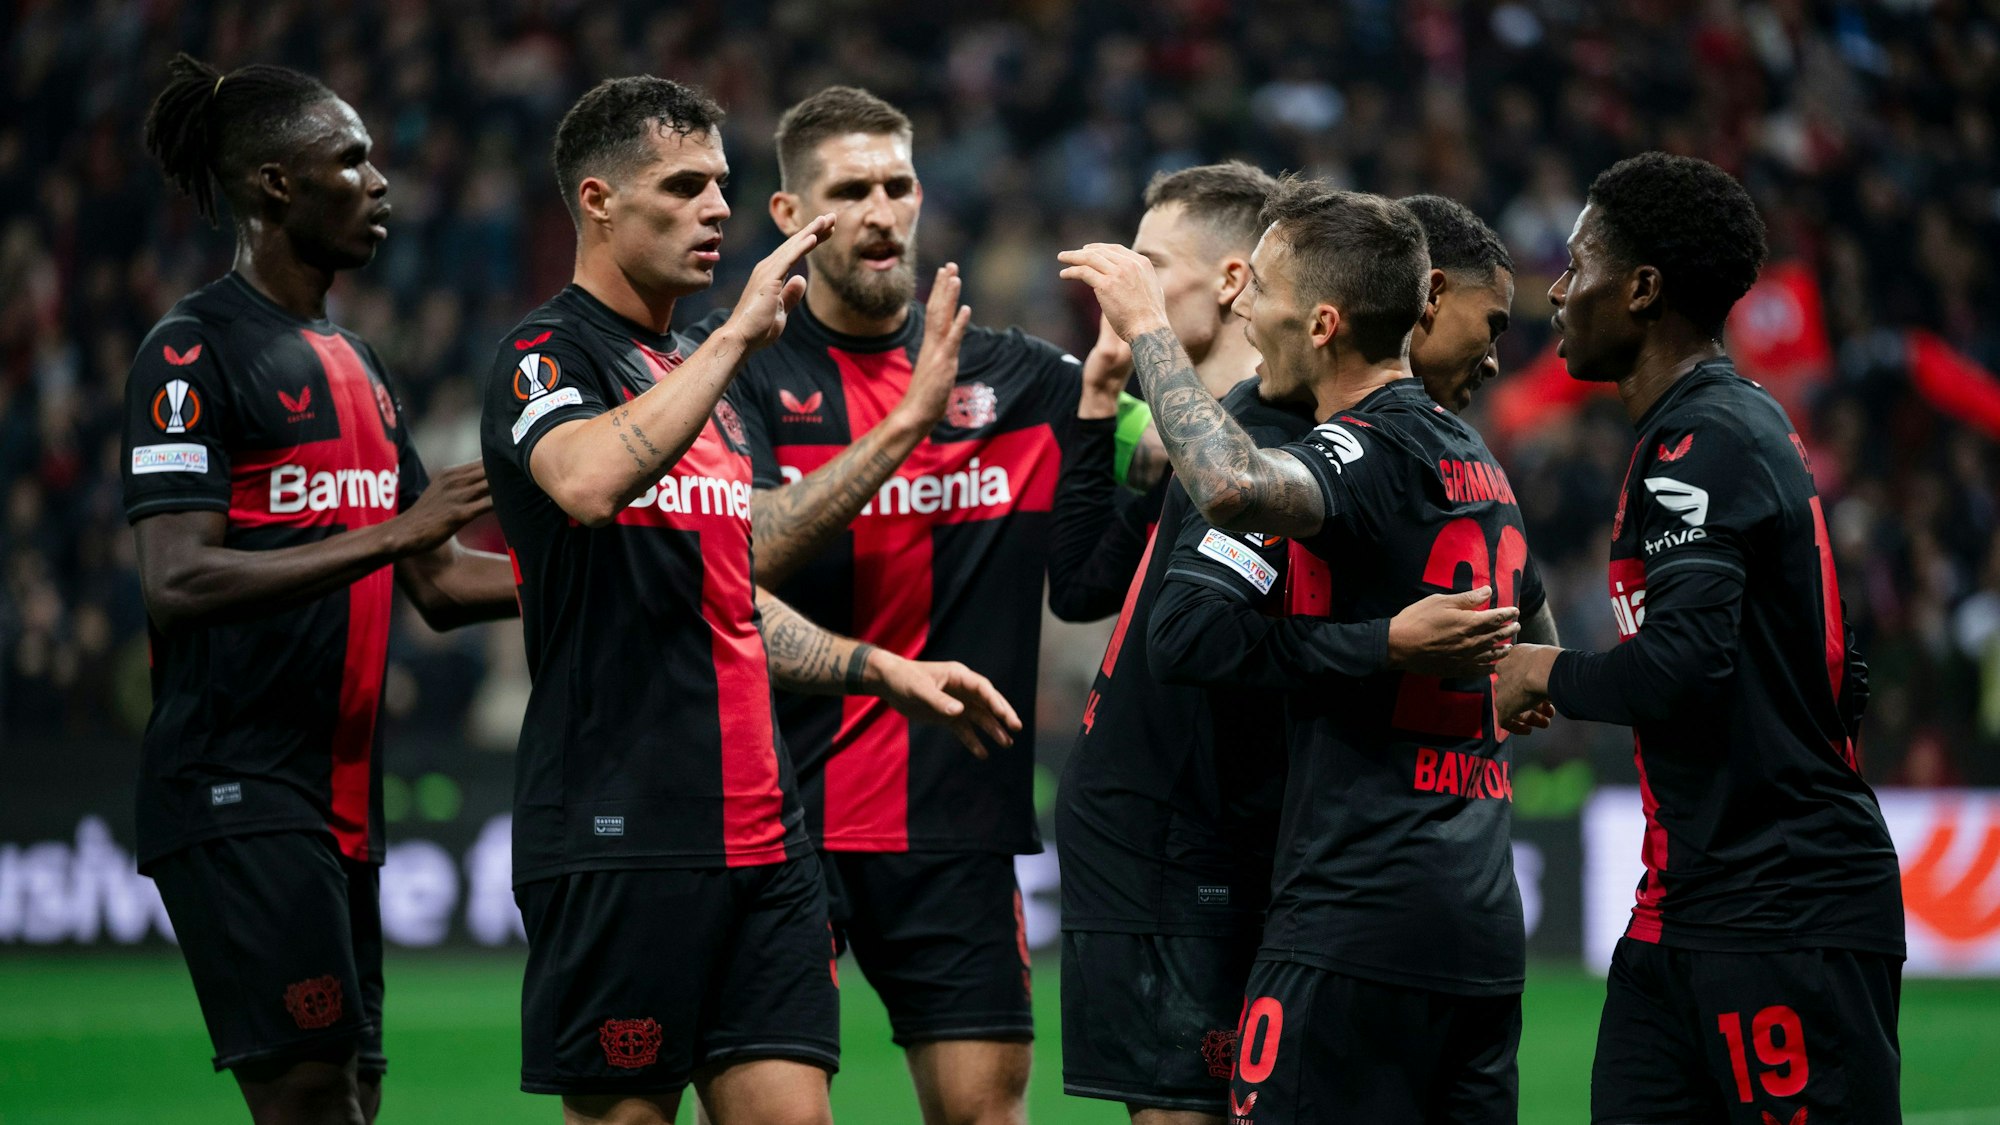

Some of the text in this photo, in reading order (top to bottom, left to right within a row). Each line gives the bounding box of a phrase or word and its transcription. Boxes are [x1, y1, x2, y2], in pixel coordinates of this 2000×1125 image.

[134, 451, 207, 465] FOUNDATION
[269, 463, 400, 514] Barme
[779, 456, 1012, 517] menia
[1203, 535, 1274, 588] FOUNDATION
[1209, 531, 1228, 543] UEFA
[1644, 527, 1708, 556] trive
[1228, 995, 1284, 1084] 0
[1717, 1004, 1810, 1103] 19
